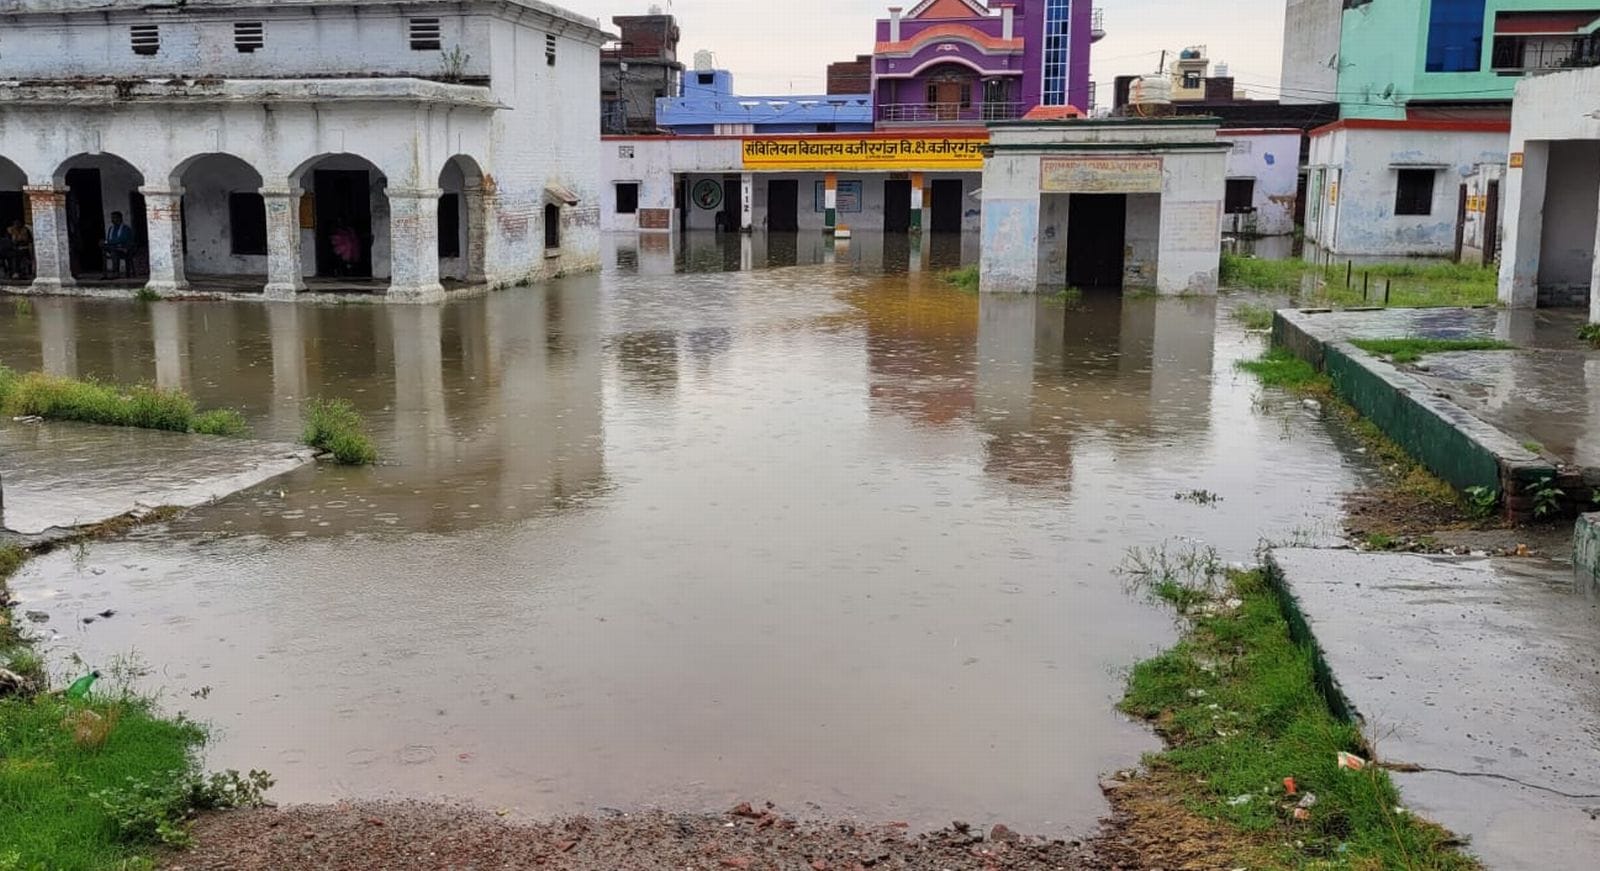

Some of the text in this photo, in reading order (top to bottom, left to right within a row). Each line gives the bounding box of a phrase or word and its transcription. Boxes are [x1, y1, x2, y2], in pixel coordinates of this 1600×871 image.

[745, 140, 796, 155] संविलियन
[799, 140, 842, 154] विद्यालय
[845, 139, 898, 154] वजीरगंज
